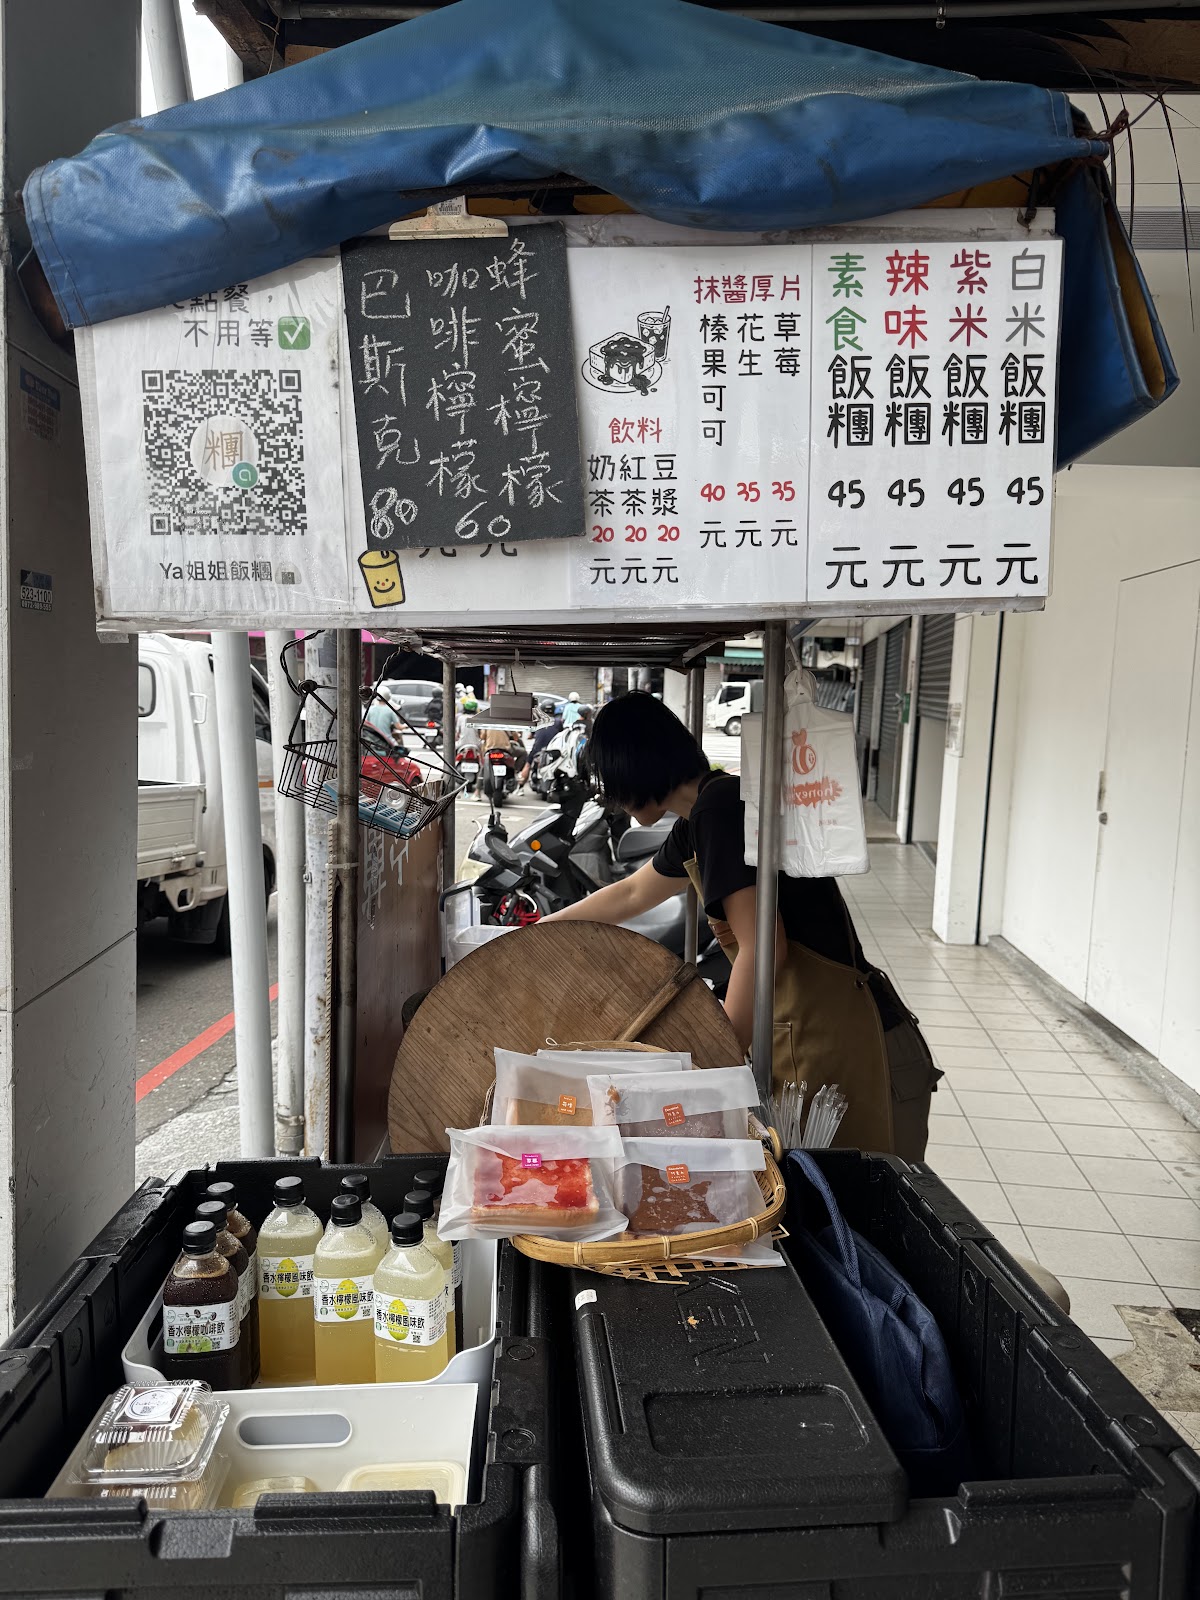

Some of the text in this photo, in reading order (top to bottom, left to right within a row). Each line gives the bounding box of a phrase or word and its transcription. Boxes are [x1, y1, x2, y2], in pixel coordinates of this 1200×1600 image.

[184, 319, 273, 348] 不用等
[358, 269, 420, 470] 巴斯克
[426, 262, 488, 498] 咖啡檸檬
[487, 238, 564, 509] 蜂蜜檸檬
[694, 275, 799, 304] 抹醬厚片
[370, 487, 418, 540] 80
[609, 417, 662, 444] 飲料
[700, 314, 729, 548] 榛果可可 40 元
[735, 313, 764, 547] 花生 35 元
[771, 312, 801, 547] 草莓 35 元
[826, 252, 874, 589] 素食飯糰 45 元
[882, 249, 931, 588] 辣味飯糰 45 元
[939, 248, 991, 587] 紫米飯糰 45 元
[996, 248, 1046, 585] 白米飯糰 45 元
[160, 561, 272, 581] Ya姐姐飯糰
[455, 502, 512, 540] 60
[588, 454, 616, 584] 奶茶 20 元
[620, 454, 647, 584] 紅茶 20 元
[652, 454, 679, 584] 豆漿 20 元
